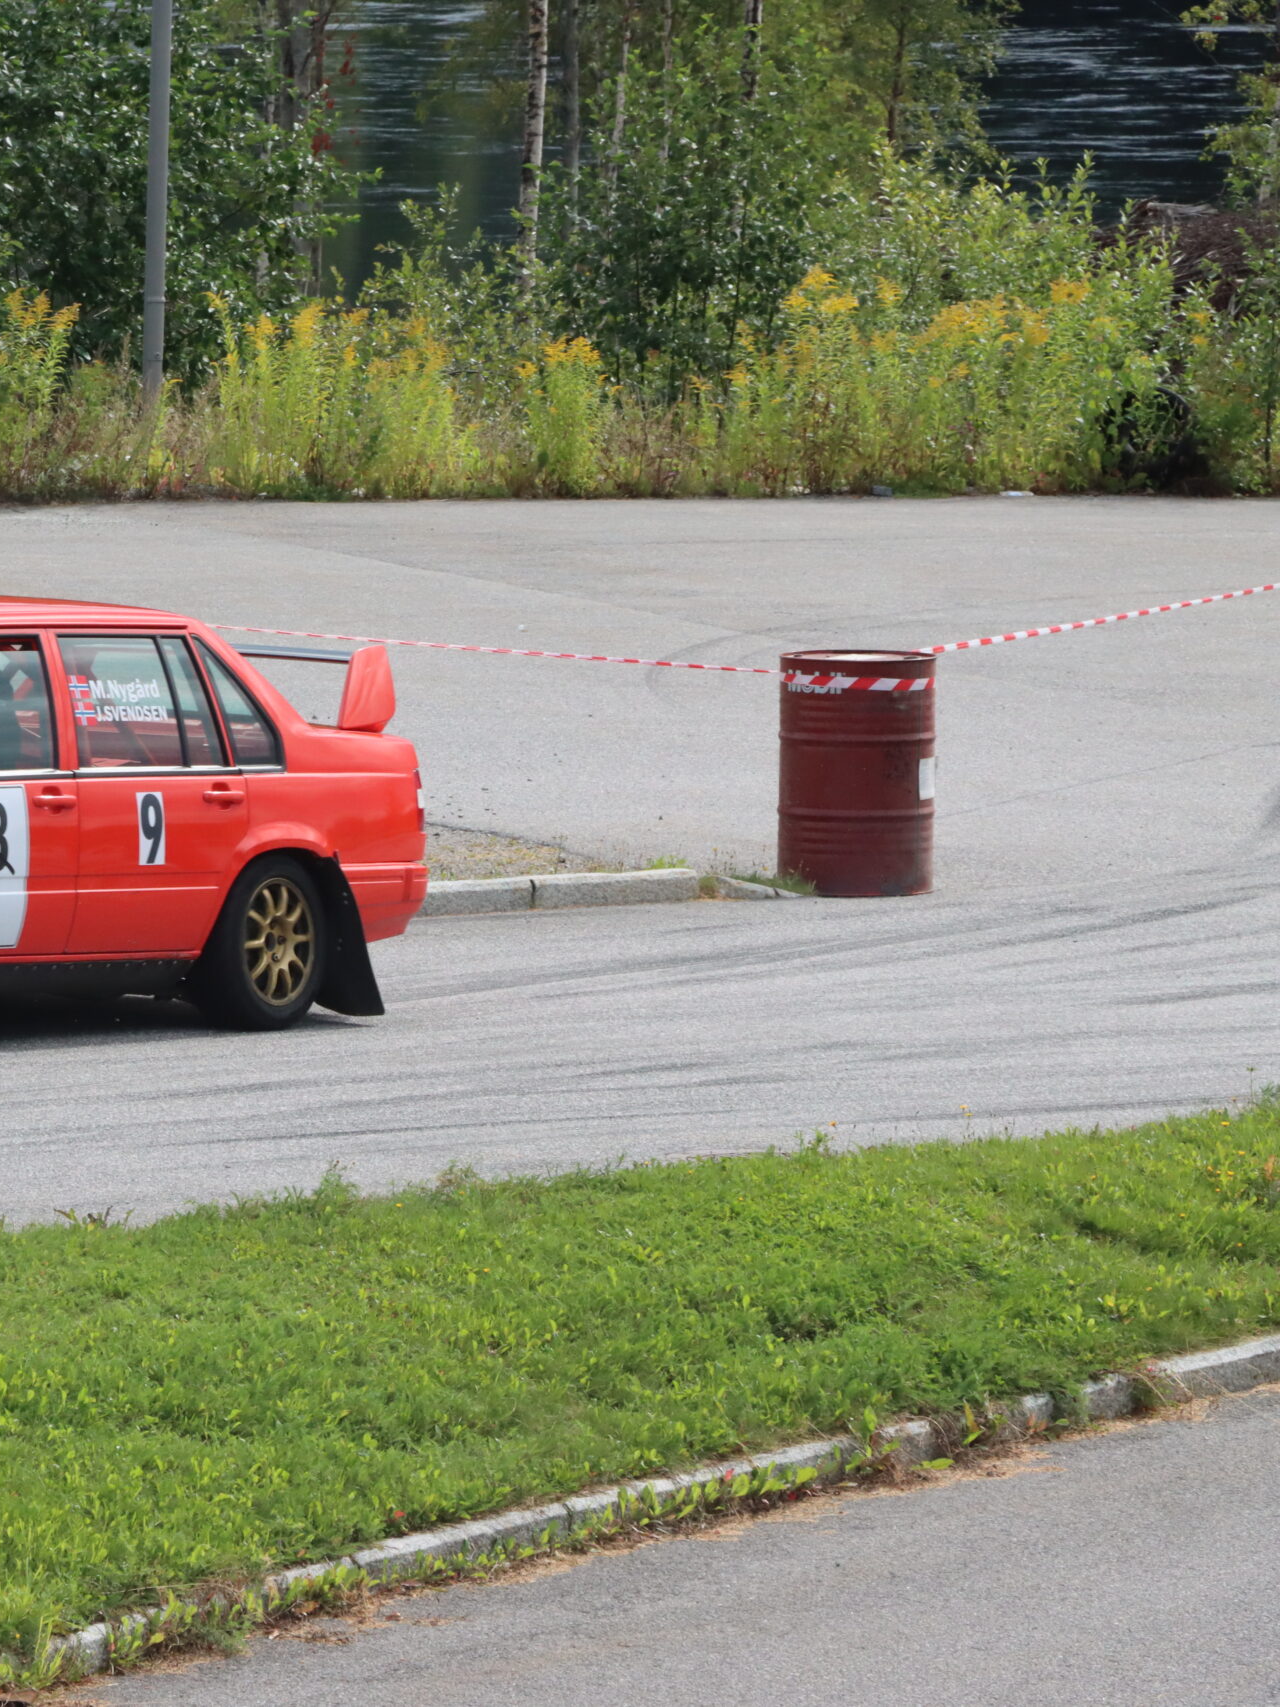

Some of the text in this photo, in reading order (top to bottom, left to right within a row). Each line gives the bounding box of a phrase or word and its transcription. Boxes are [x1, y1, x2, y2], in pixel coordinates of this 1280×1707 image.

[88, 678, 160, 703] M.Nygård
[96, 705, 168, 722] J.SVENDSEN
[140, 793, 163, 865] 9
